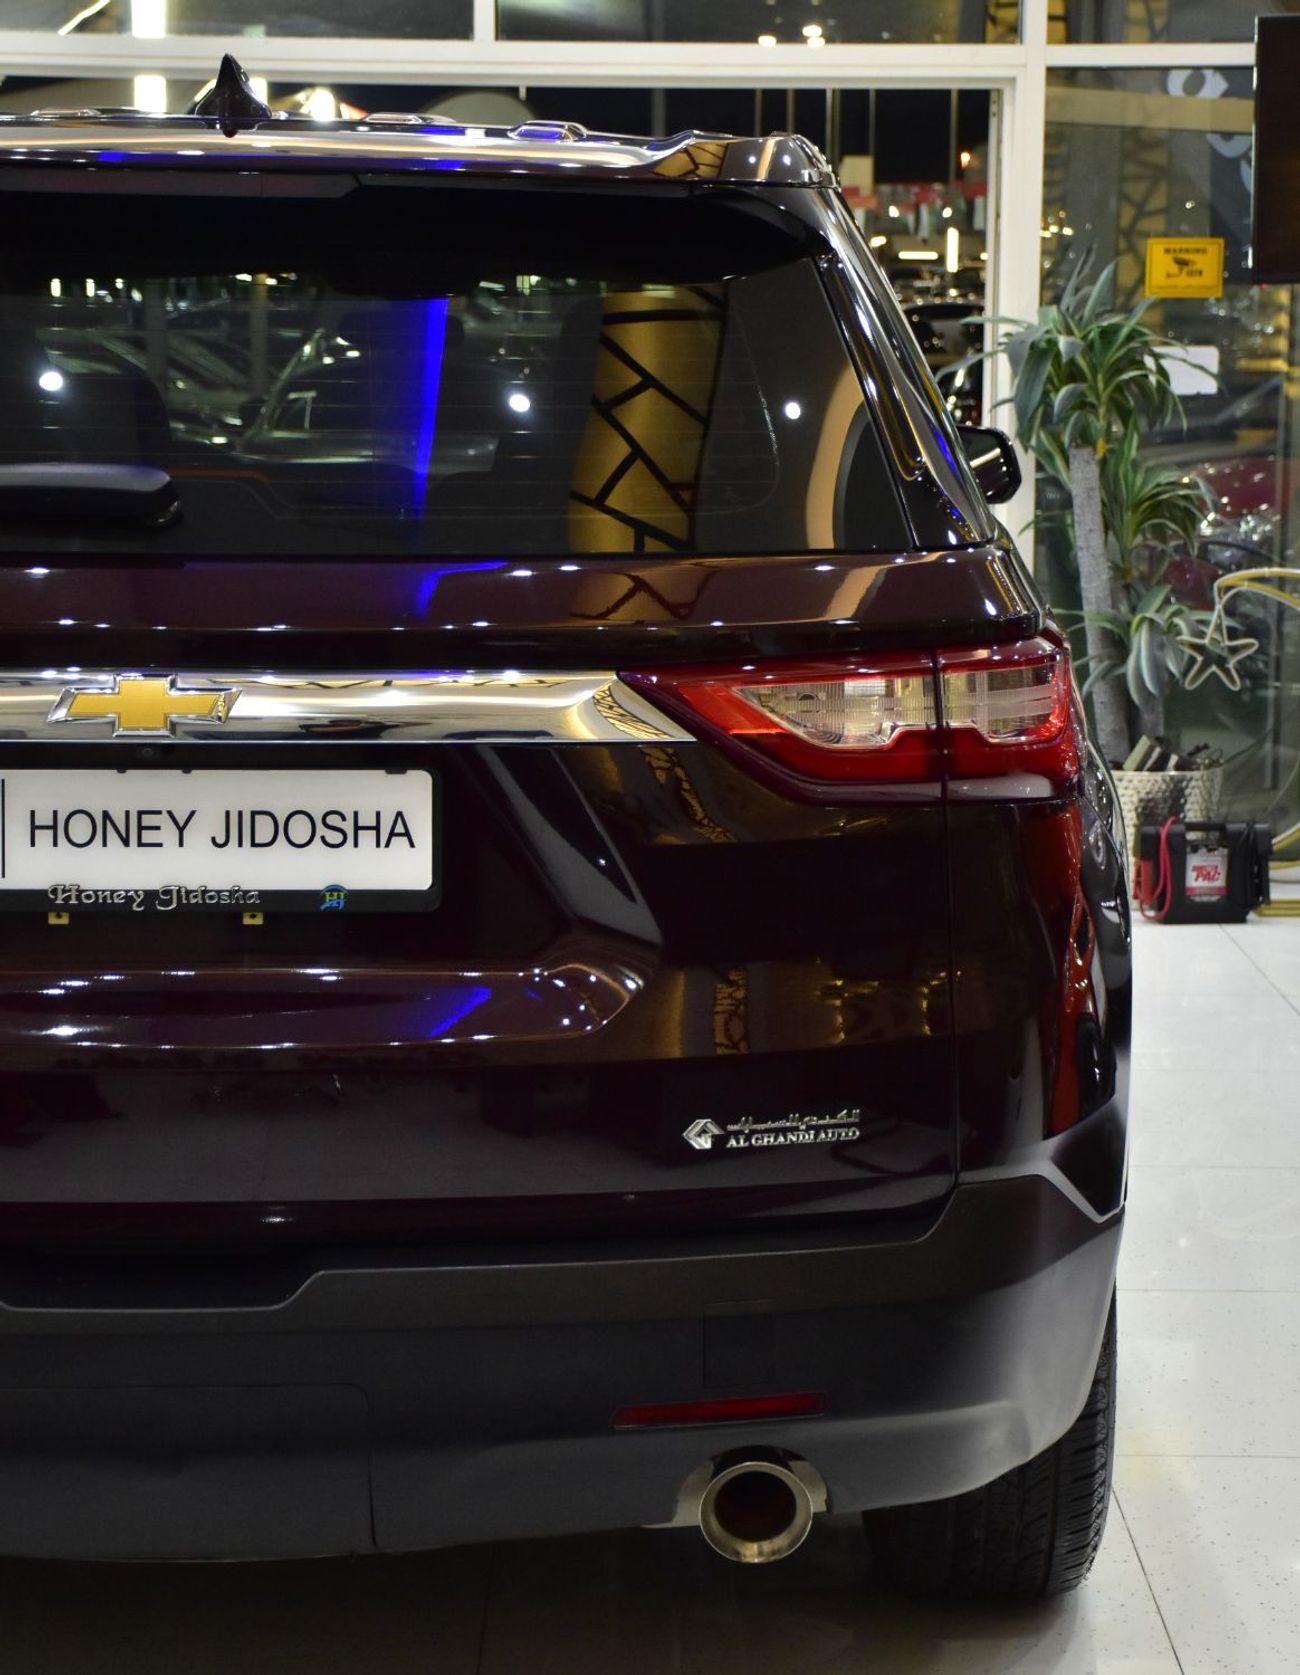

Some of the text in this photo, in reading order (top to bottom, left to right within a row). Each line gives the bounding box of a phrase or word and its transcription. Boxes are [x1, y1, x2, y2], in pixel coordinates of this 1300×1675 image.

[29, 809, 416, 848] HONEY JIDOSHA
[47, 883, 261, 911] Honey Jidosha
[726, 1127, 860, 1148] AL GHANDI AUTO
